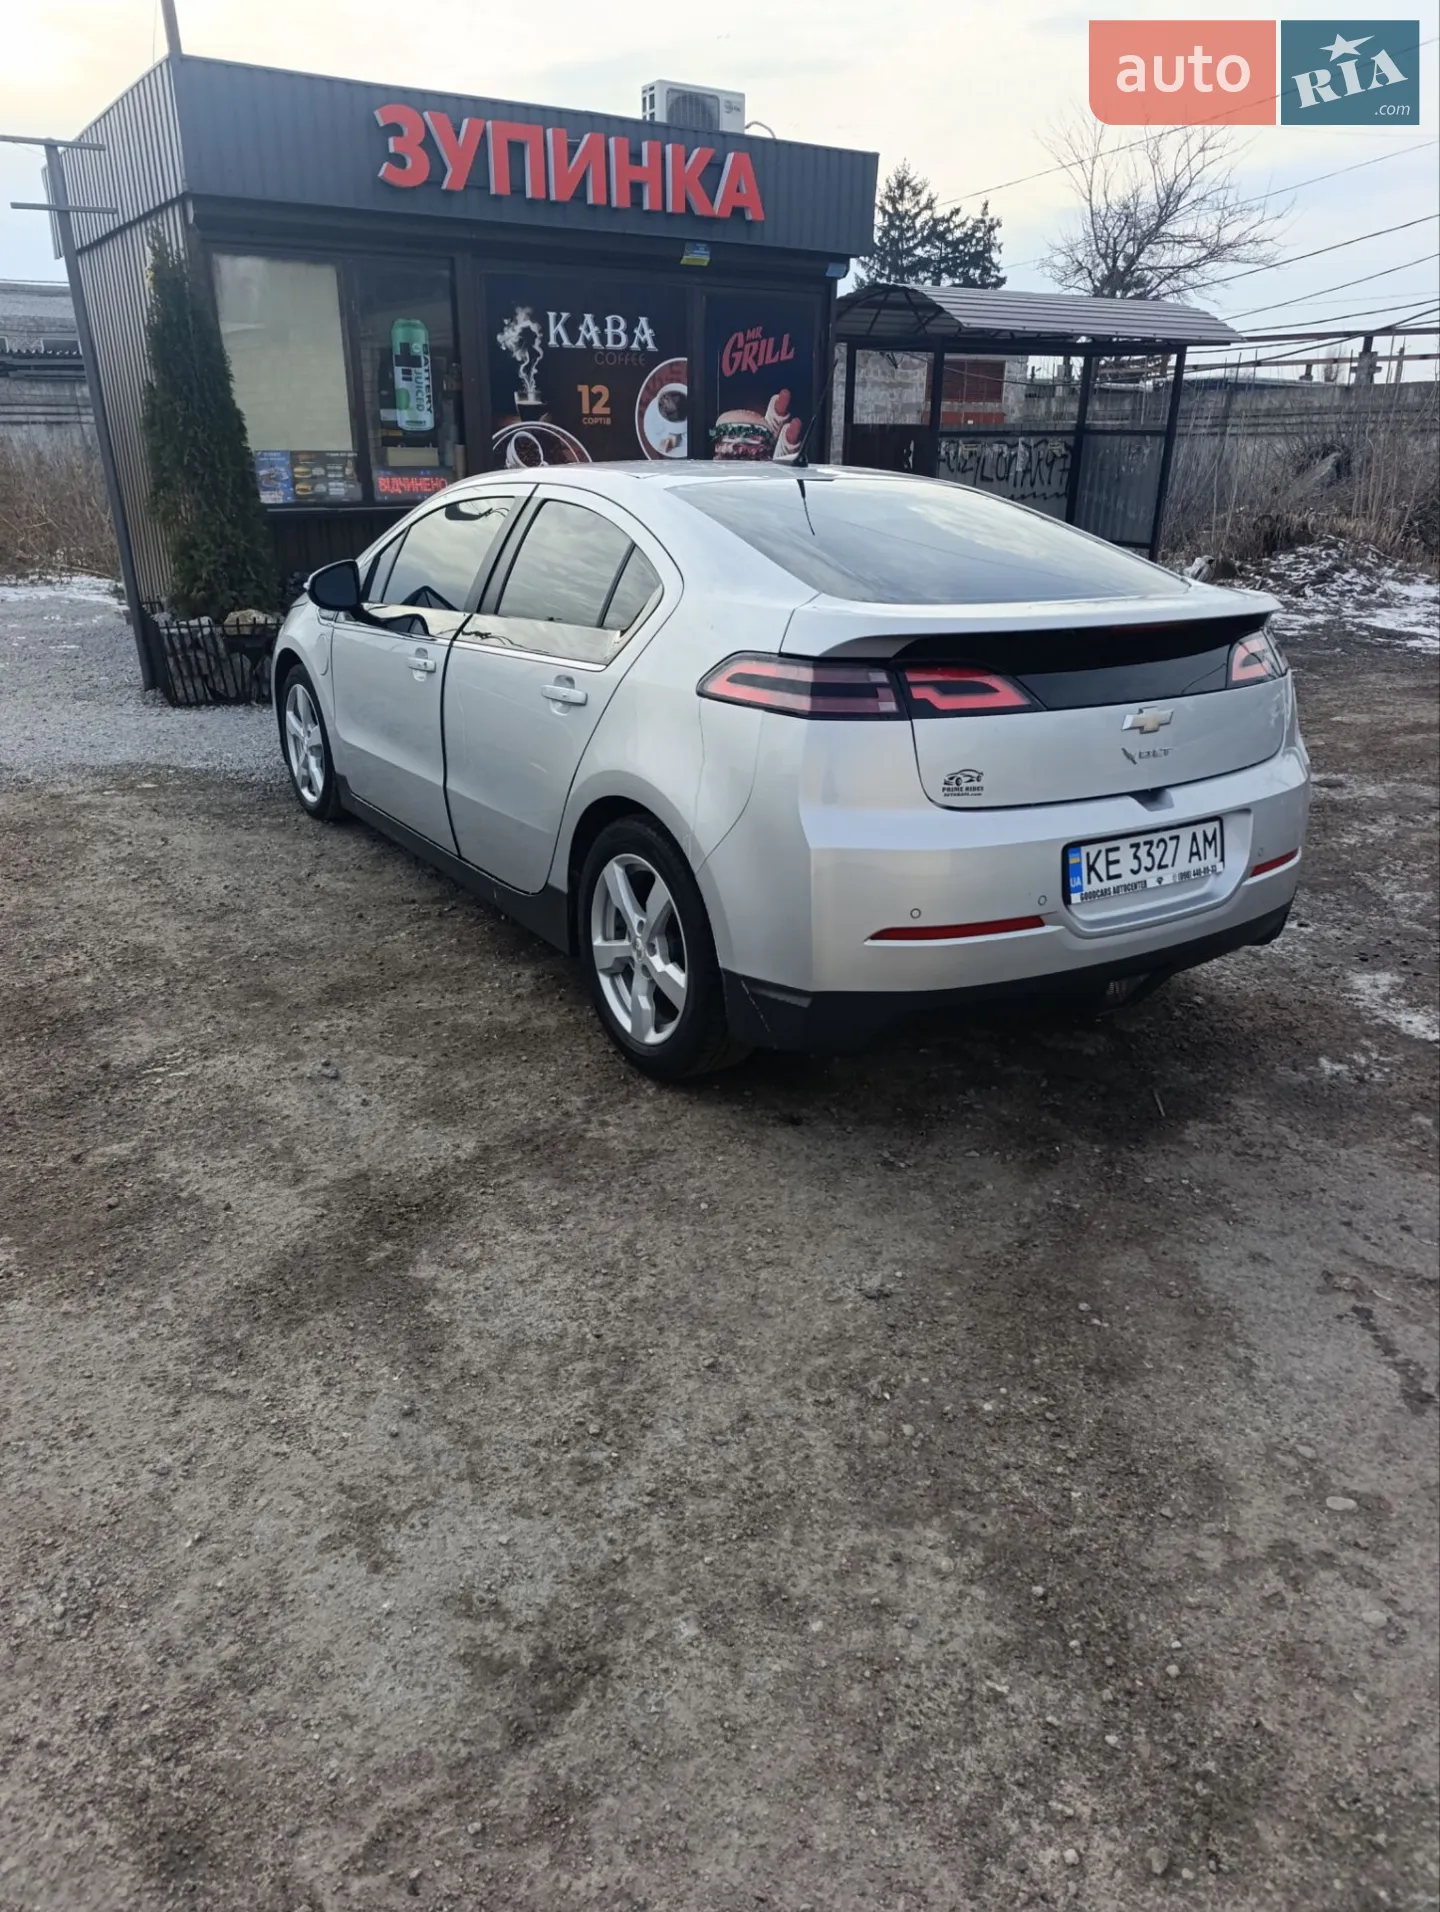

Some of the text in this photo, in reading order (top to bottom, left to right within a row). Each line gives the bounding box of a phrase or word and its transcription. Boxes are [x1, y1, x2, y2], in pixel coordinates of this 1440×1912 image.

[373, 103, 765, 222] ЗУПИНКА
[546, 311, 659, 352] КАВА
[746, 326, 763, 341] MR
[594, 351, 646, 367] COFFEE
[721, 331, 795, 378] GRILL
[414, 369, 426, 412] JUICED
[422, 343, 433, 414] BATTERY
[577, 384, 611, 415] 12
[582, 416, 612, 425] СОРТІВ
[1086, 827, 1218, 885] KE 3327 AM
[1070, 876, 1082, 888] UA
